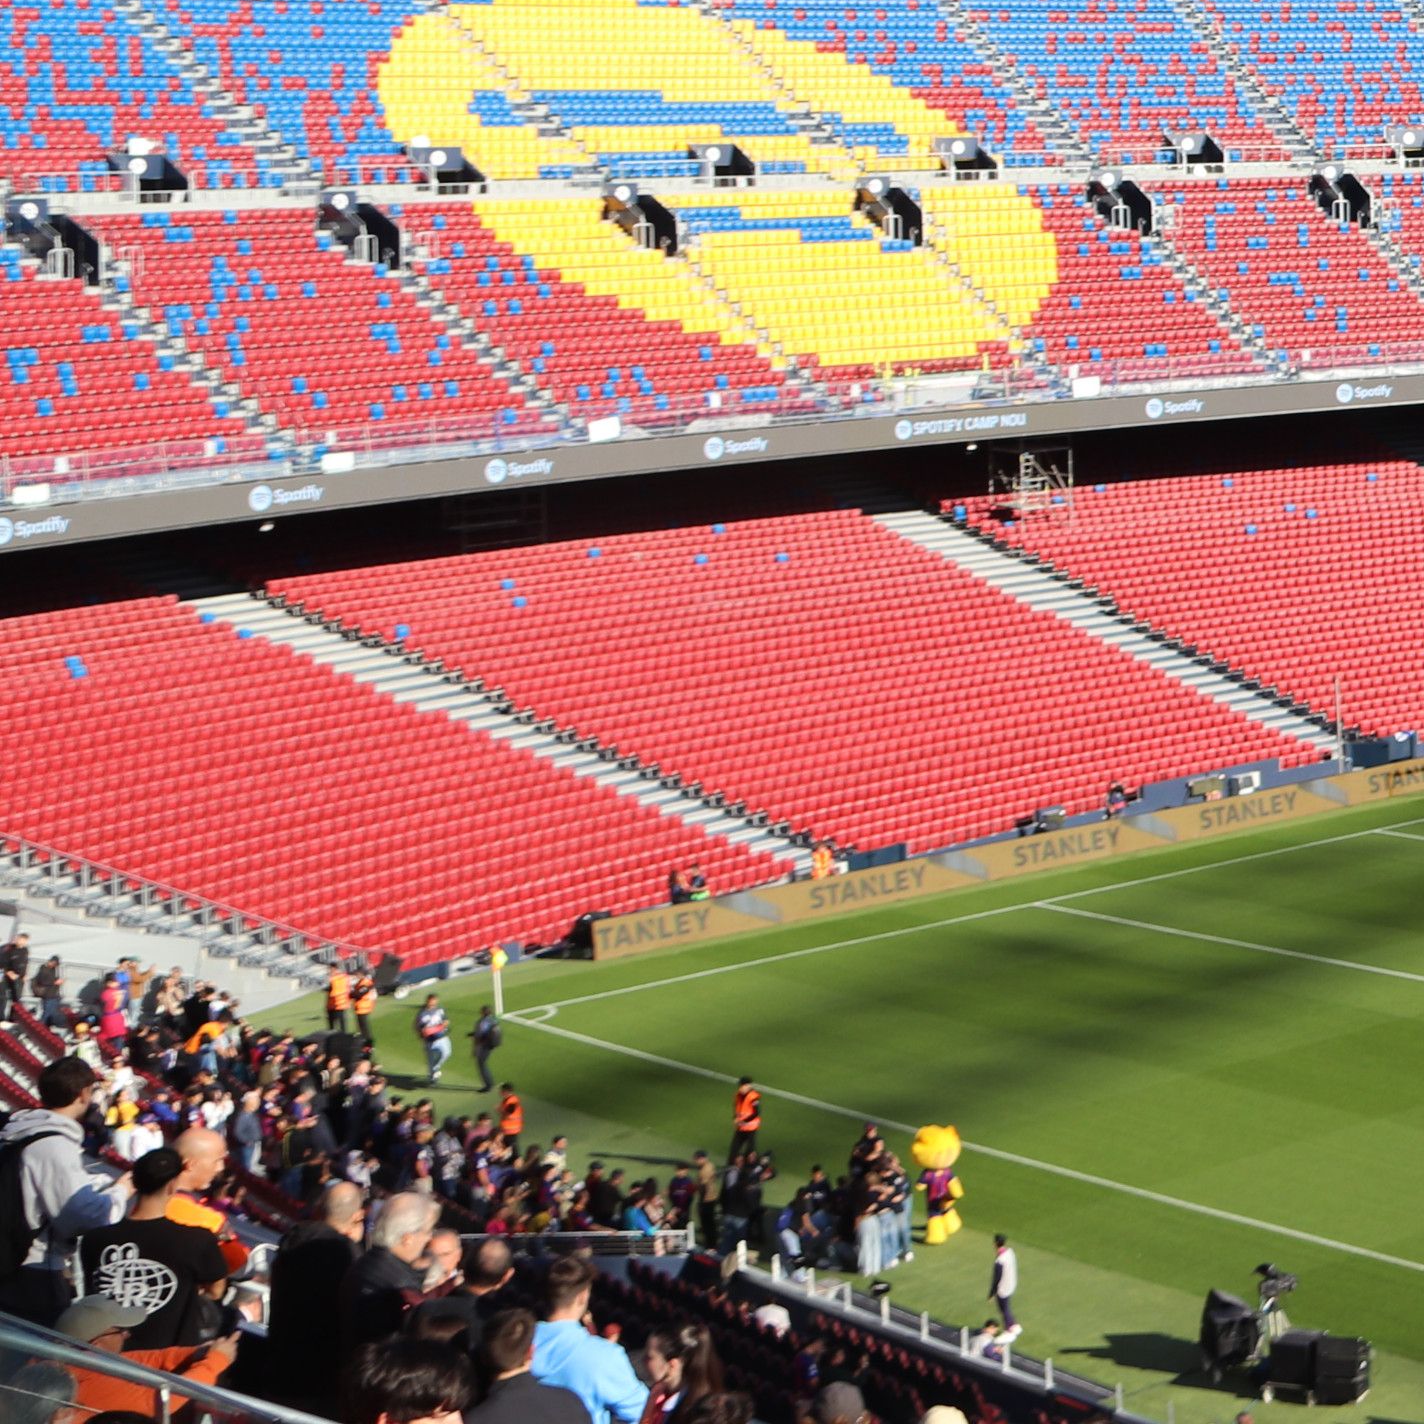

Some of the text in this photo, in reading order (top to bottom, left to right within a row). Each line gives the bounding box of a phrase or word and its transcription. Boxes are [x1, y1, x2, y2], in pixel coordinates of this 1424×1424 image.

[1354, 384, 1393, 400] Spotify
[1164, 399, 1204, 416] Spotify
[913, 413, 1027, 436] SPOTIFY CAMP NOU
[507, 458, 554, 478] Spotify
[273, 485, 324, 504] Spotify
[1200, 792, 1297, 829] STANLEY
[1014, 827, 1120, 867] STANLEY
[809, 864, 927, 909] STANLEY
